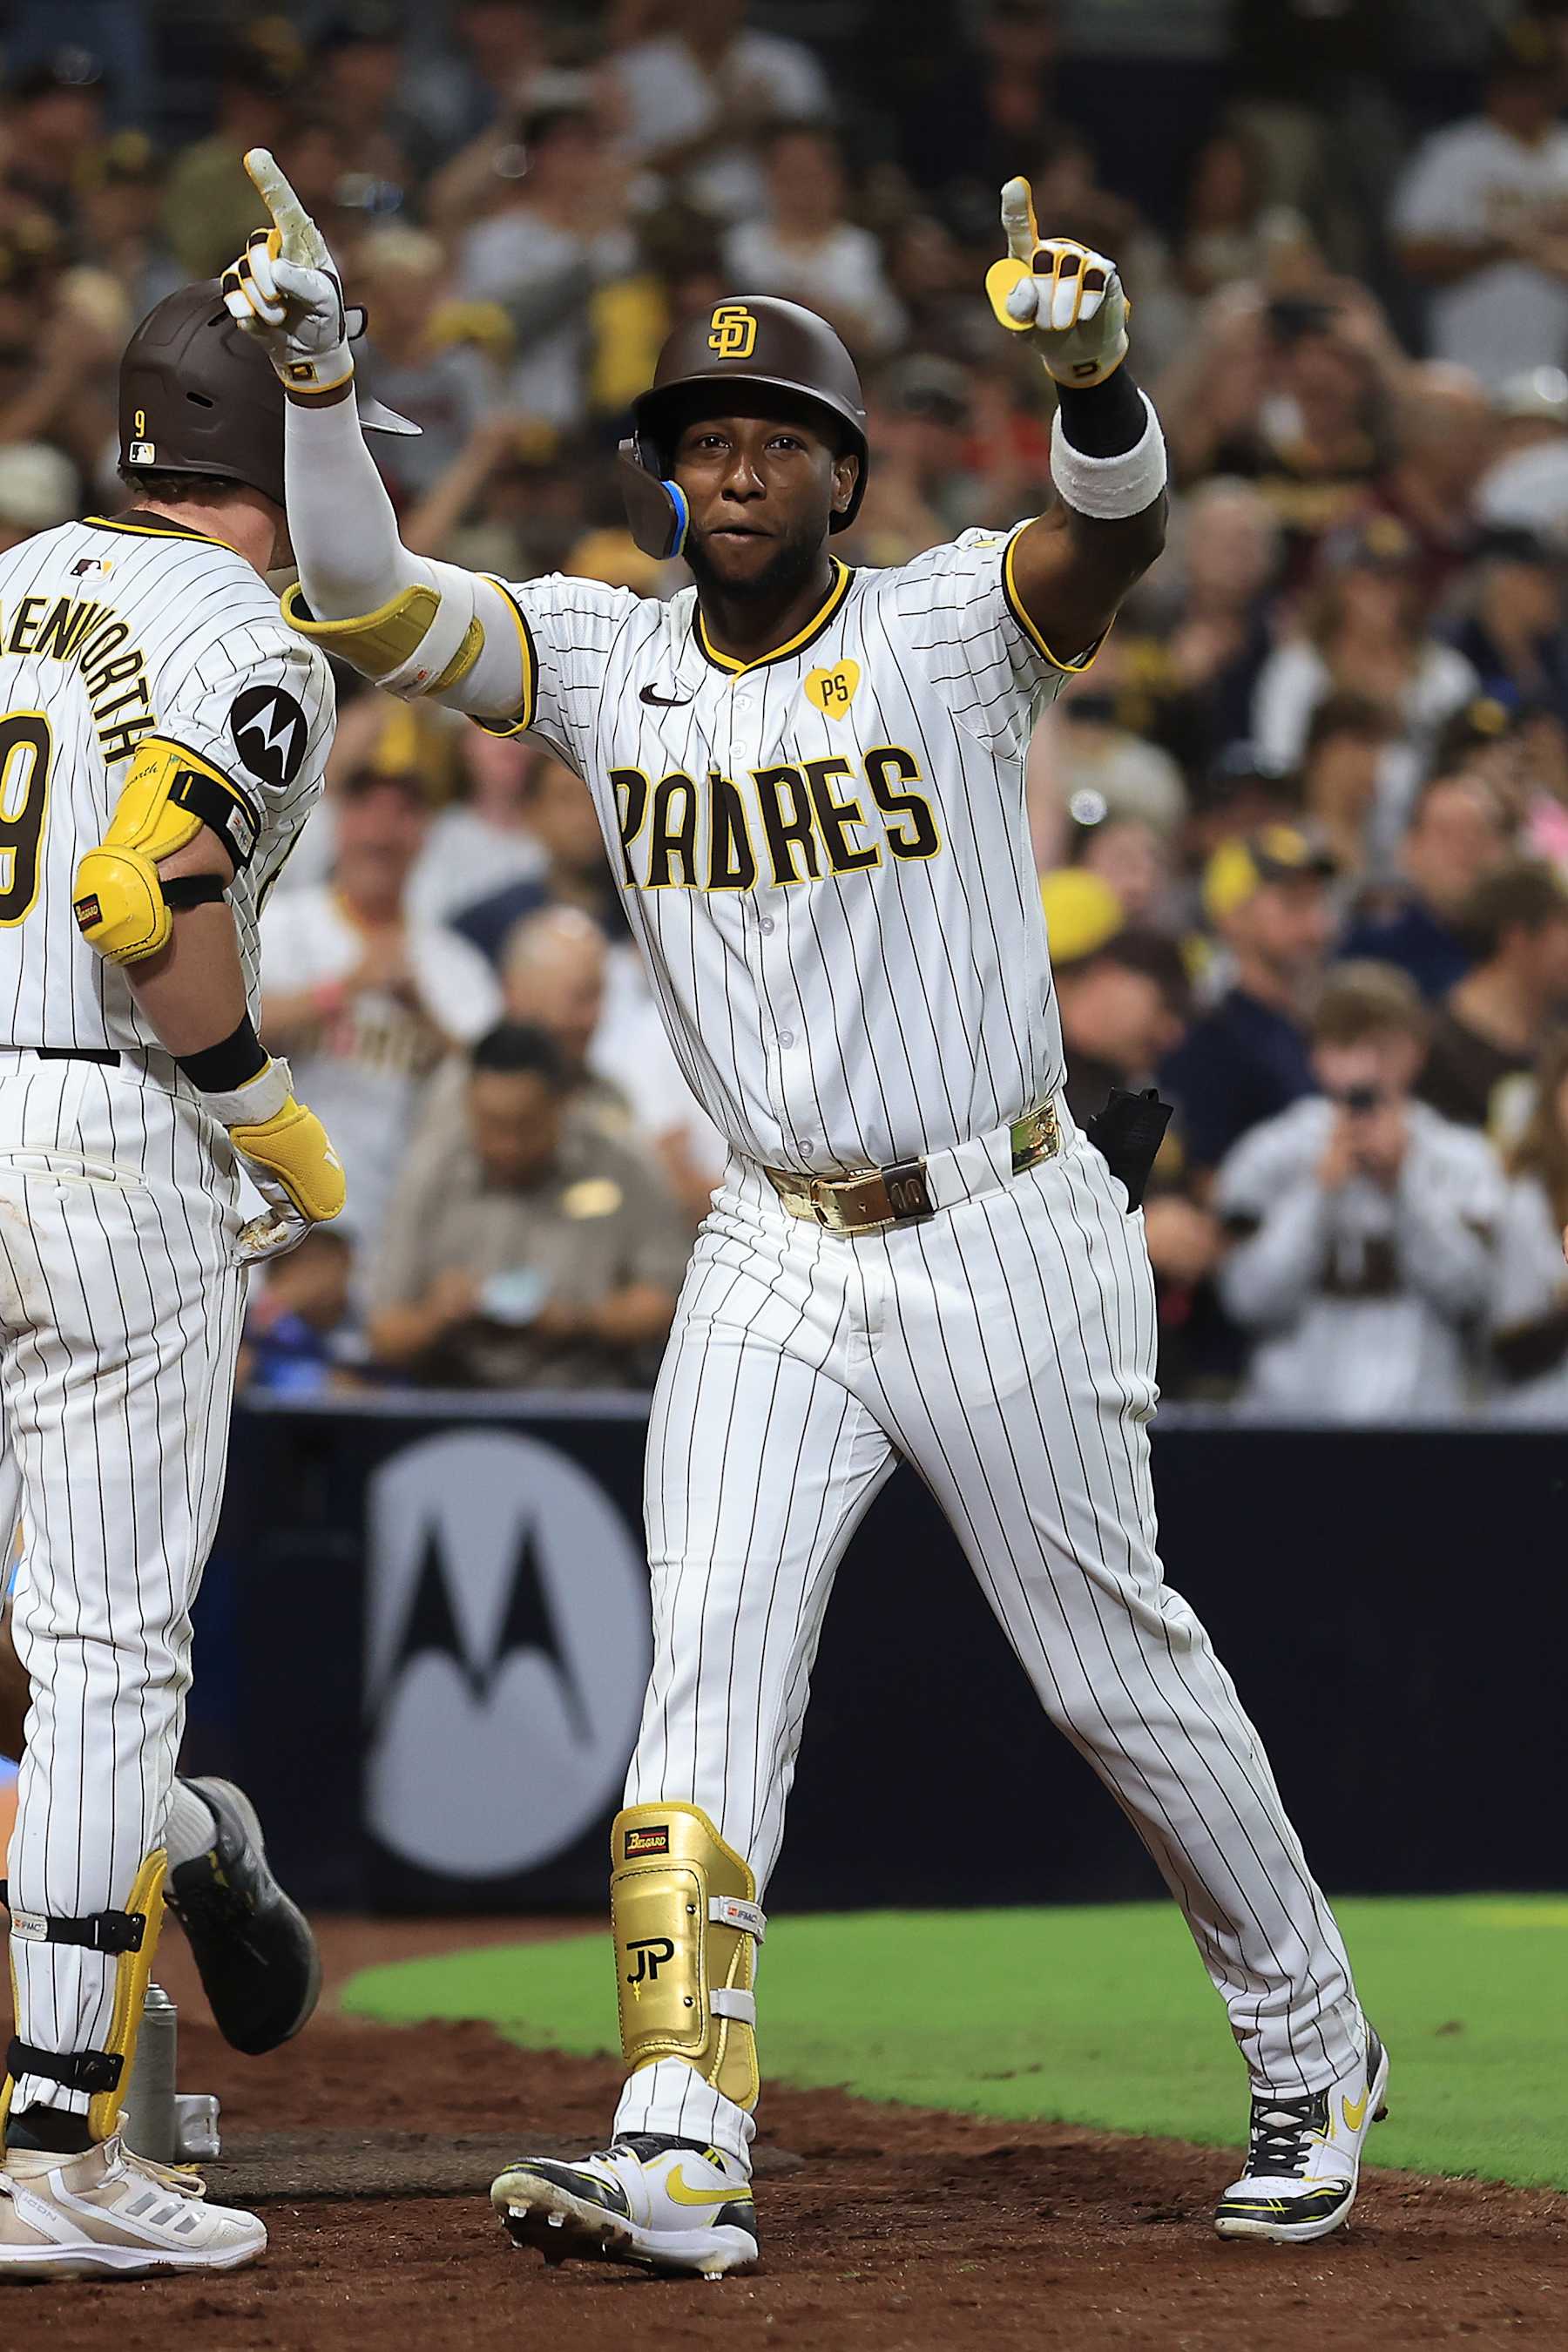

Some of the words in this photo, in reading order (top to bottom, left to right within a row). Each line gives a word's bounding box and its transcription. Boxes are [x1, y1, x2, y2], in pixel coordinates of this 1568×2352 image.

[134, 409, 145, 437] 9
[0, 597, 159, 767] ENWORTH
[821, 674, 848, 706] PS
[0, 710, 53, 929] 9
[607, 745, 942, 893] PADRES
[626, 1937, 675, 1984] JP
